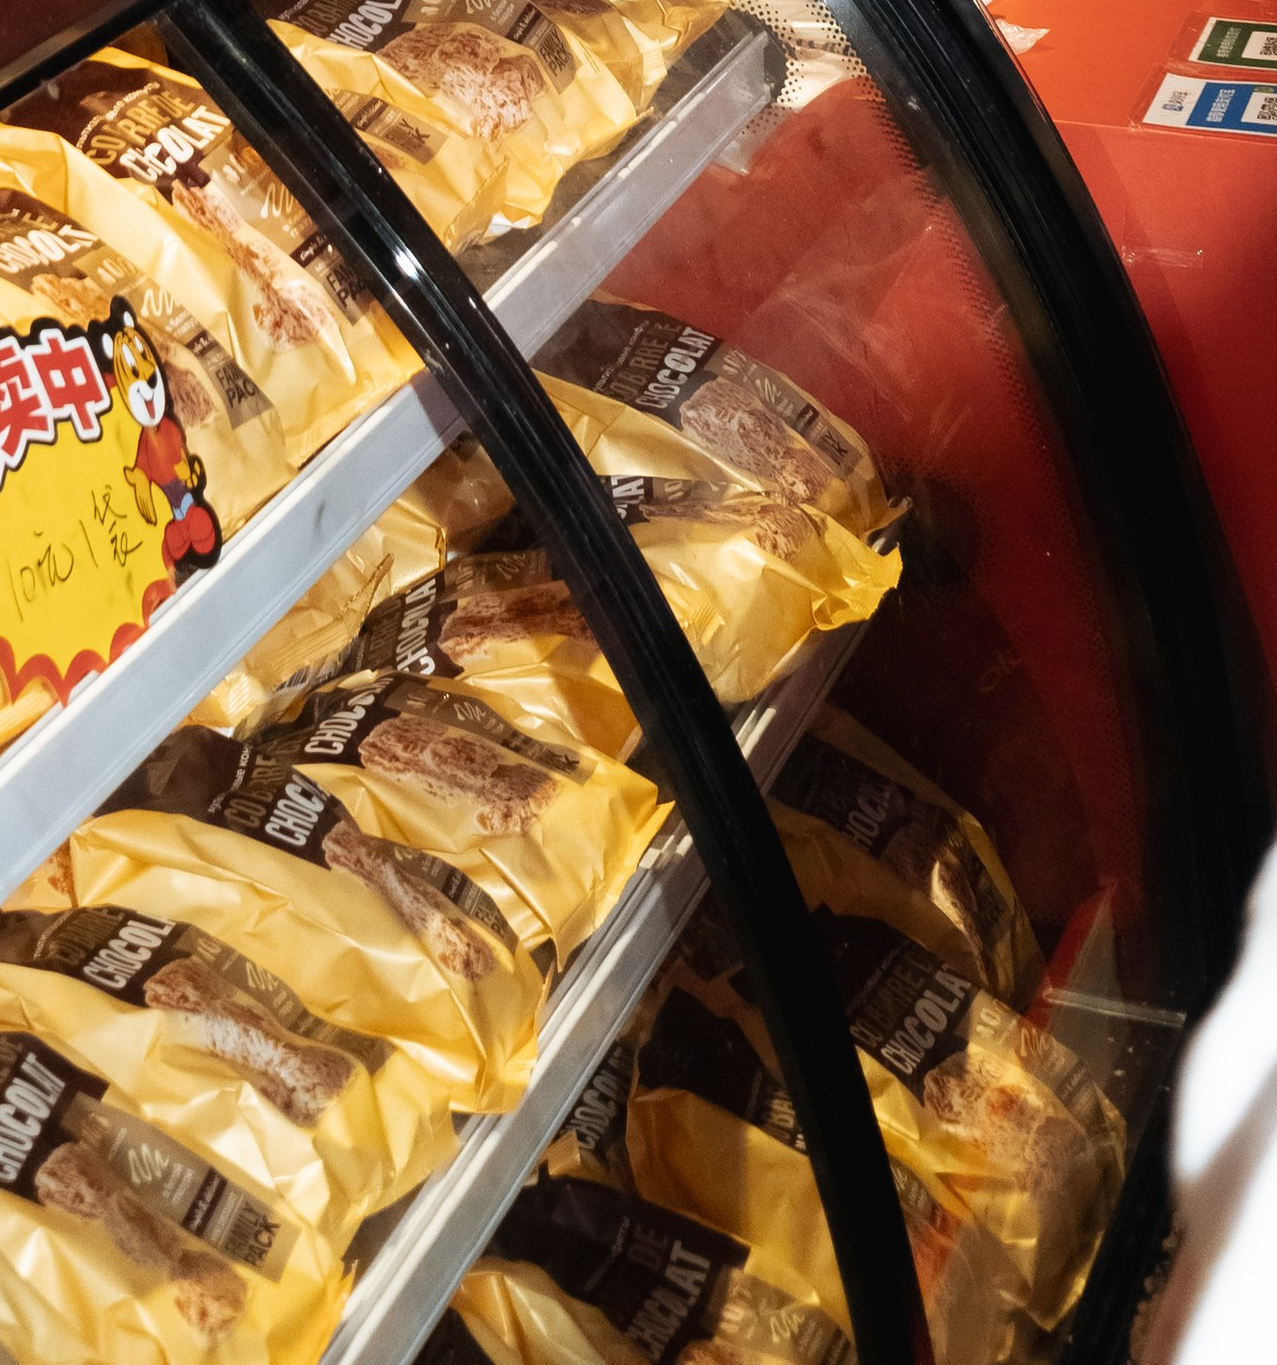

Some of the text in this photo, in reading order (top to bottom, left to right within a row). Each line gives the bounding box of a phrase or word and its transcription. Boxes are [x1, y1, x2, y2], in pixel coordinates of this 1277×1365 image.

[538, 27, 563, 64] FAMILY
[547, 43, 572, 78] PACK
[84, 130, 127, 166] CO
[150, 88, 196, 119] DE
[119, 104, 233, 185] CHCOLAT
[225, 378, 257, 409] PAC
[634, 325, 716, 410] CHOCOLAT
[395, 577, 437, 677] CHOCOLA
[223, 797, 267, 829] CO
[880, 962, 972, 1075] CHOCOLA
